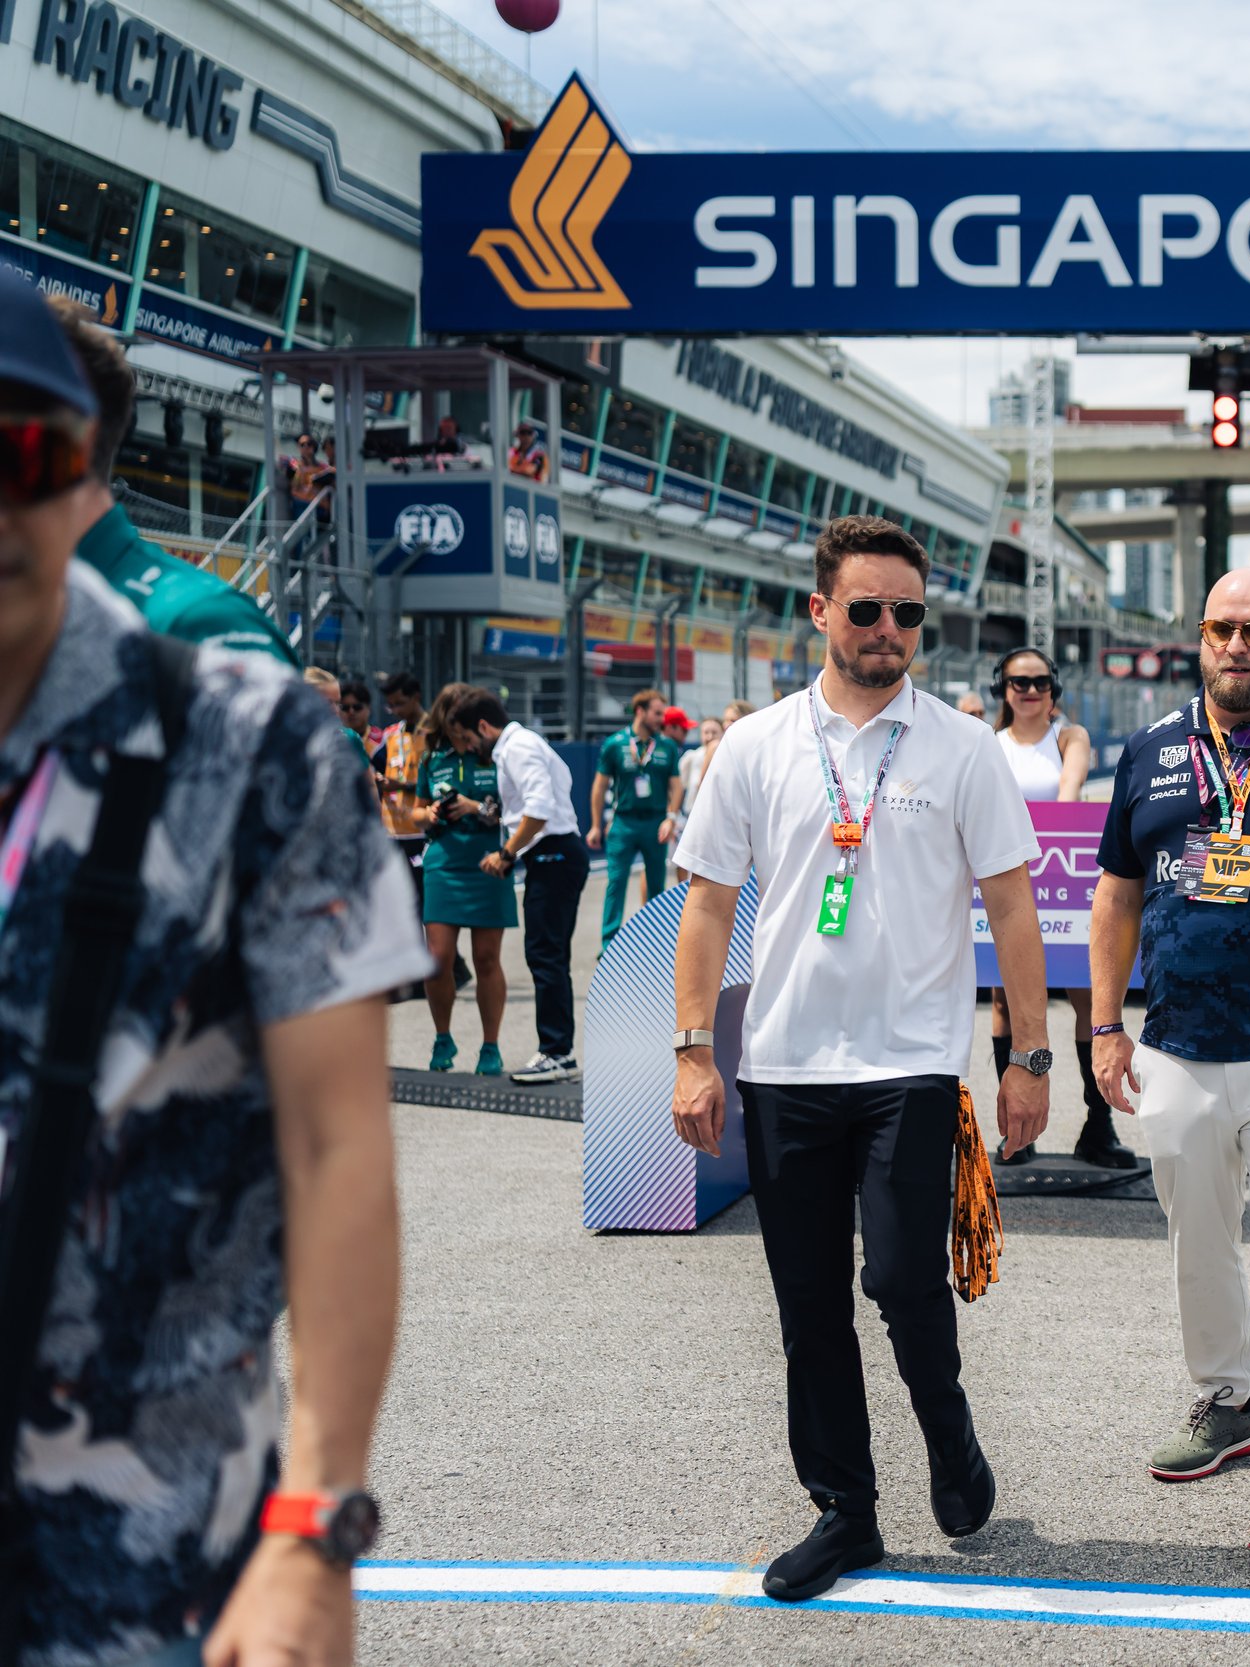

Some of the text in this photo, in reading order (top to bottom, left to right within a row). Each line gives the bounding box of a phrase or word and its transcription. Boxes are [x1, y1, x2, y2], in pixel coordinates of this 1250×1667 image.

[33, 0, 245, 151] RACING
[135, 307, 208, 347] SINGAPORE
[400, 513, 459, 545] FIA
[1163, 747, 1187, 756] TAG
[1161, 754, 1187, 767] HEUER
[1151, 774, 1179, 788] Mobil
[1149, 788, 1188, 801] ORACLE
[881, 796, 931, 808] EXPERT
[1156, 850, 1182, 883] Re
[975, 920, 1074, 934] SIORE
